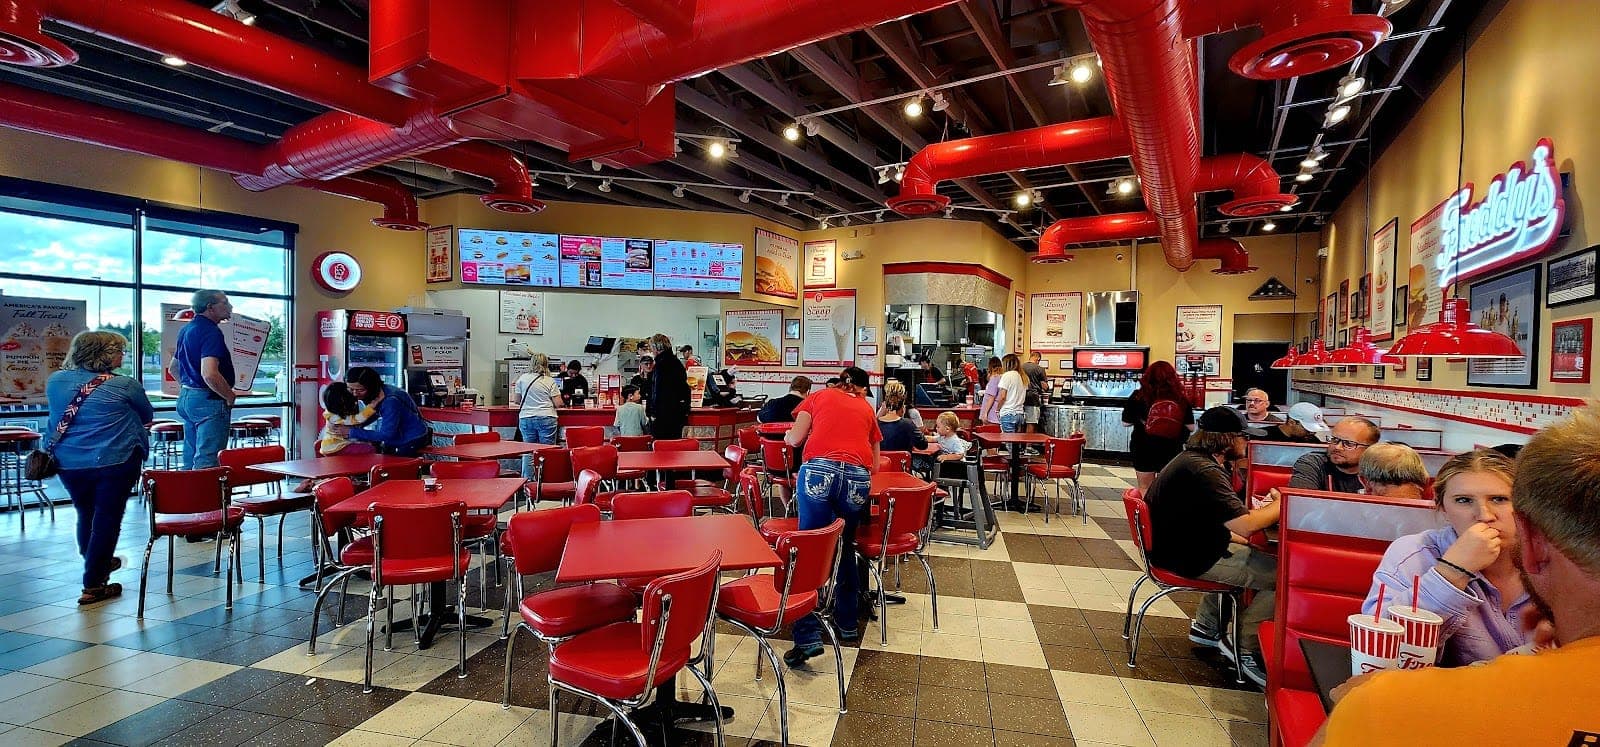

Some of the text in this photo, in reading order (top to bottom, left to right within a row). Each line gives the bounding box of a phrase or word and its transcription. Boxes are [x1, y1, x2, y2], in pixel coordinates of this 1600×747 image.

[1436, 146, 1558, 282] Freddy's
[13, 309, 68, 319] Fall Treat!
